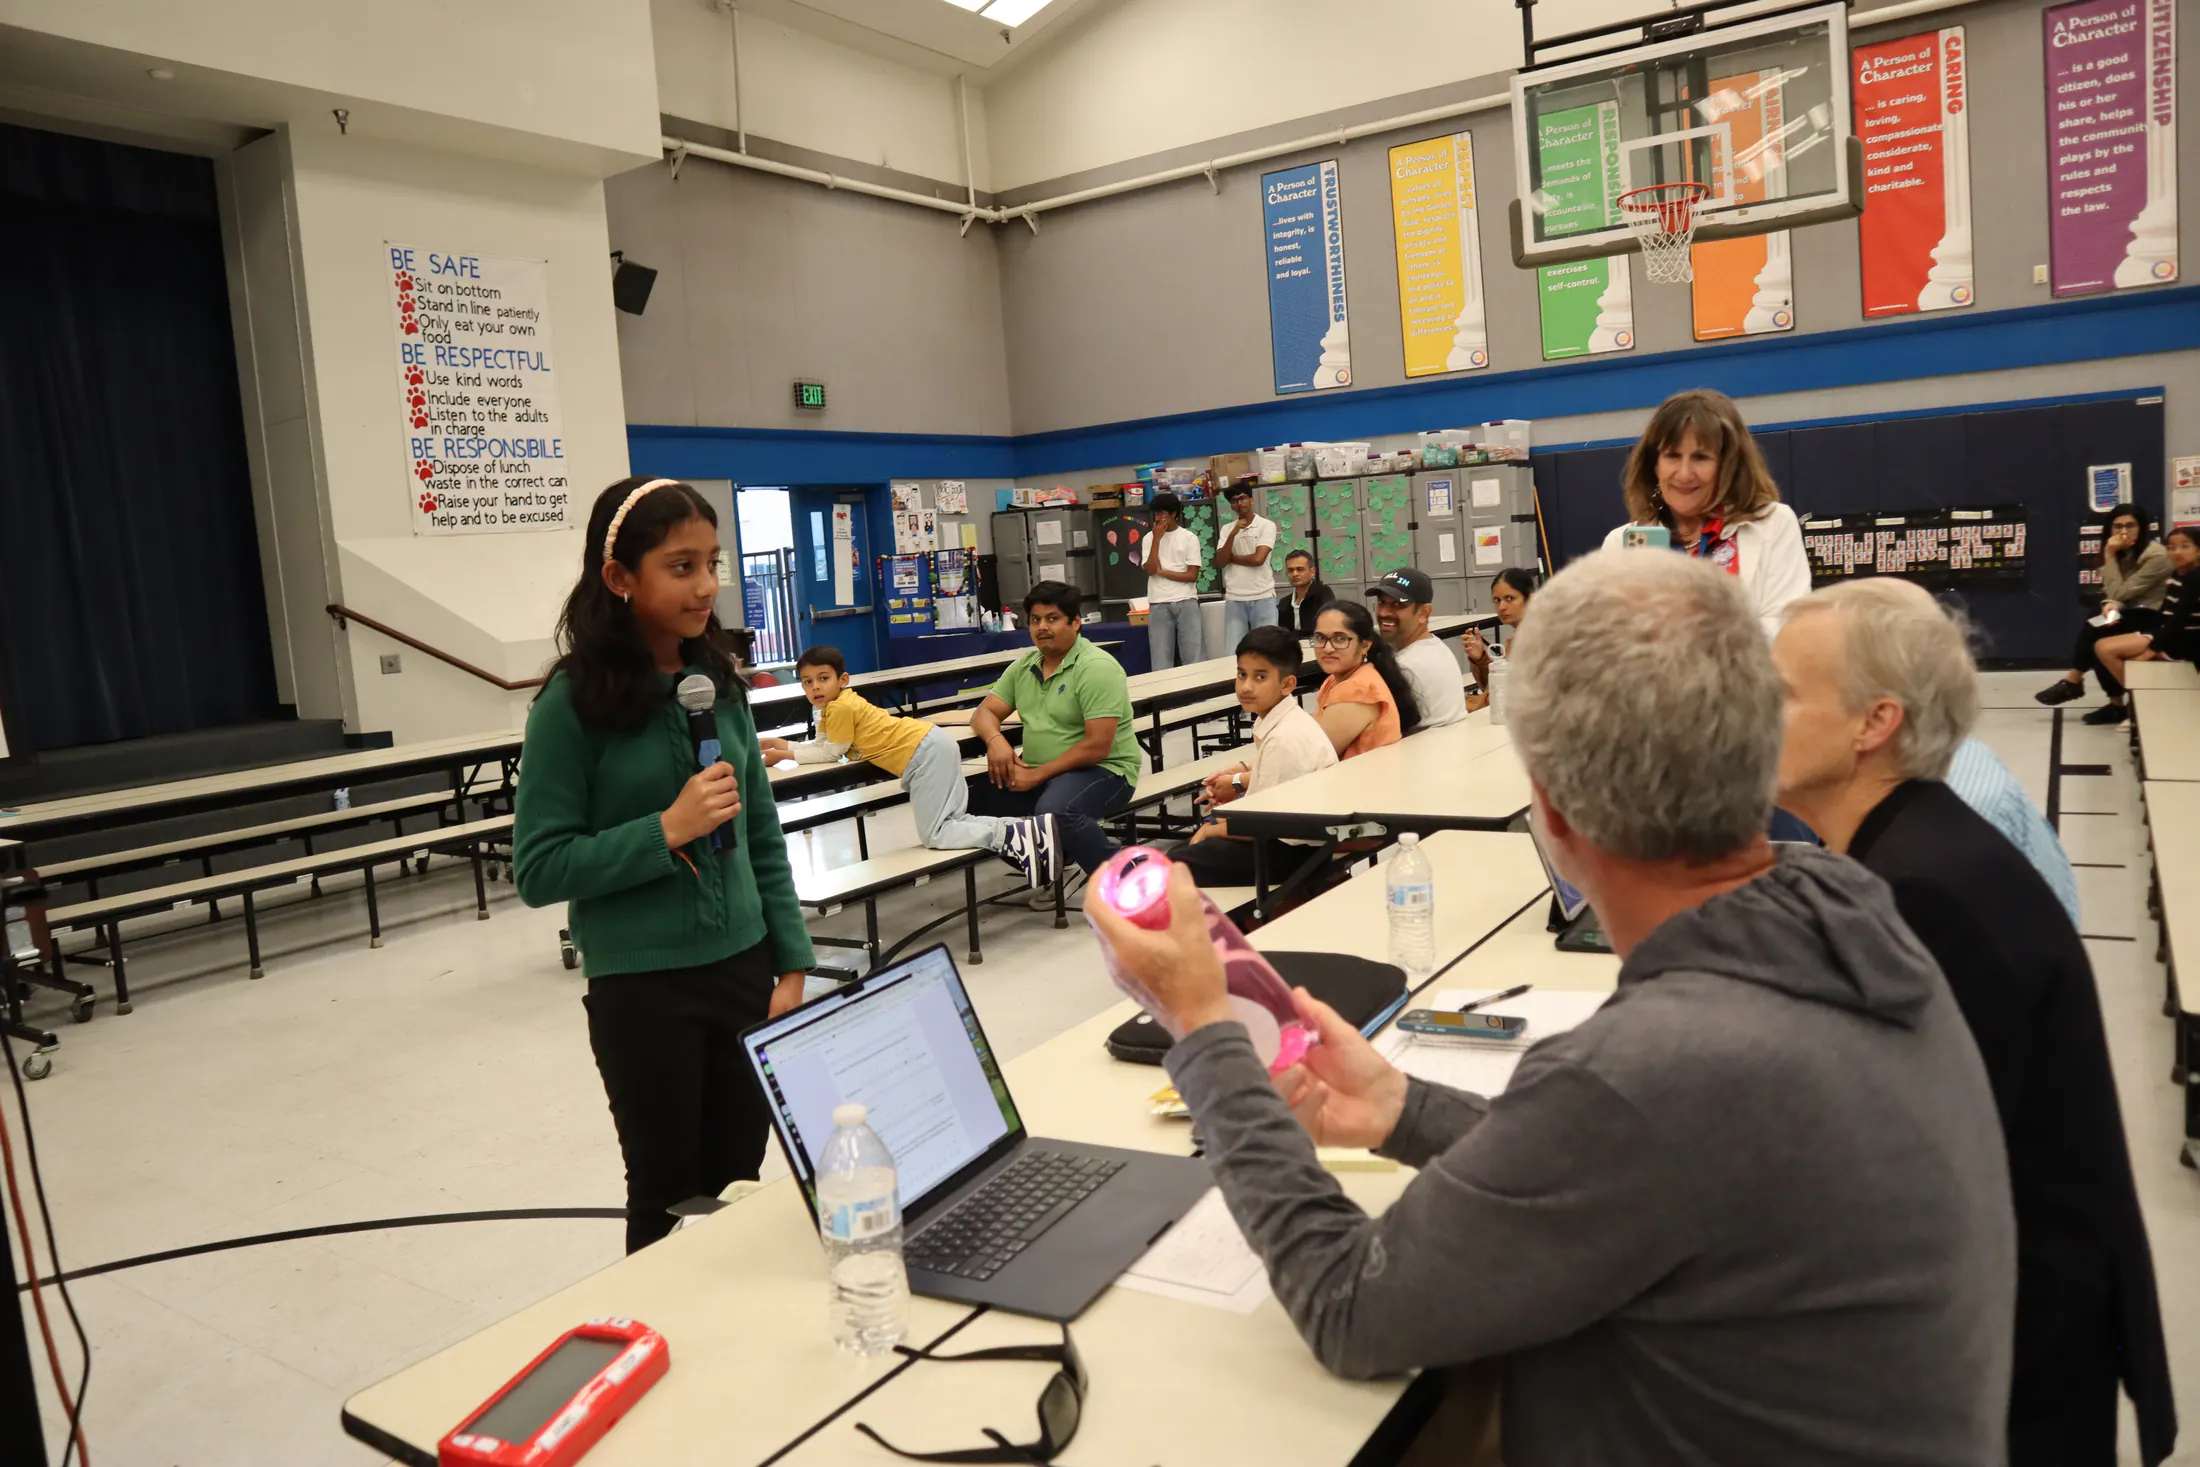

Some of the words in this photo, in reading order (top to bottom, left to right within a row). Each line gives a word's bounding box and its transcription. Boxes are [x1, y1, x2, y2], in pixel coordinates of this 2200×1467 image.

[2054, 22, 2065, 33] A
[2069, 12, 2118, 30] Person
[2122, 5, 2135, 18] of
[2053, 20, 2138, 48] Character
[1861, 61, 1870, 71] A
[1874, 54, 1916, 69] Person
[1919, 47, 1931, 59] of
[2072, 63, 2083, 73] is
[2097, 54, 2128, 69] good
[2153, 0, 2171, 127] ITIZENSHIP
[1860, 62, 1933, 84] Character
[1945, 36, 1963, 115] CARING
[2058, 80, 2101, 94] citizen,
[2105, 71, 2135, 84] does
[1878, 100, 1887, 109] is
[1890, 93, 1926, 106] caring,
[2058, 101, 2076, 111] his
[2079, 98, 2092, 107] or
[2096, 93, 2117, 104] her
[1546, 123, 1580, 136] Person
[1582, 118, 1592, 127] of
[1865, 115, 1901, 128] loving,
[2059, 116, 2096, 129] share,
[2100, 108, 2134, 122] helps
[2059, 136, 2079, 146] the
[1867, 142, 1932, 160] considerate,
[2060, 152, 2091, 166] plays
[2095, 149, 2109, 159] by
[2113, 143, 2134, 154] the
[1396, 162, 1449, 179] Character
[1583, 172, 1591, 180] of
[1603, 109, 1622, 225] RESPONSIBIL
[1868, 165, 1890, 176] kind
[1893, 161, 1913, 172] and
[2060, 169, 2090, 181] rules
[2094, 164, 2117, 175] and
[1277, 180, 1305, 192] Person
[1307, 176, 1315, 185] of
[1868, 177, 1925, 193] charitable.
[2061, 184, 2112, 199] respects
[1268, 187, 1317, 205] Character
[1297, 212, 1314, 220] with
[2061, 205, 2080, 216] the
[2084, 202, 2110, 212] law.
[1273, 228, 1306, 239] integrity,
[1544, 221, 1578, 233] pursues
[1274, 242, 1301, 252] honest,
[1324, 167, 1345, 323] TRUSTWORTHINESS
[391, 248, 416, 271] BE
[429, 254, 480, 278] SAFE
[1275, 255, 1302, 266] reliable
[1276, 271, 1289, 279] and
[1291, 268, 1311, 277] loyal.
[1547, 264, 1587, 276] exercises
[415, 278, 432, 293] Sit
[438, 284, 453, 295] on
[456, 282, 501, 299] bottom
[418, 296, 453, 312] Stand
[457, 300, 468, 313] in
[471, 301, 491, 315] line
[497, 307, 539, 323] patiently
[419, 314, 449, 332] Only
[455, 320, 474, 332] eat
[478, 322, 504, 336] your
[510, 325, 535, 336] own
[422, 330, 451, 344] food
[402, 343, 426, 365] BE
[435, 345, 550, 371] RESPECTFUL
[426, 370, 449, 385] Use
[456, 372, 481, 387] kind
[487, 375, 522, 388] words
[428, 389, 470, 406] Include
[477, 396, 531, 410] everyone
[803, 385, 822, 404] EXIT
[429, 408, 466, 421] Listen
[472, 409, 485, 422] to
[488, 408, 507, 422] the
[515, 409, 548, 423] adults
[431, 422, 441, 435] in
[446, 420, 485, 439] charge
[412, 438, 436, 458] BE
[433, 460, 479, 477] Dispose
[484, 460, 497, 473] of
[500, 460, 531, 473] lunch
[425, 476, 461, 490] waste
[467, 477, 476, 489] in
[480, 476, 498, 489] the
[505, 476, 544, 488] correct
[549, 476, 568, 487] can
[438, 494, 469, 508] Raise
[473, 495, 498, 512] your
[505, 492, 532, 506] hand
[536, 494, 547, 505] to
[550, 493, 568, 508] get
[432, 512, 457, 529] help
[461, 511, 481, 525] and
[485, 513, 497, 524] to
[502, 510, 516, 523] be
[520, 509, 563, 522] excused
